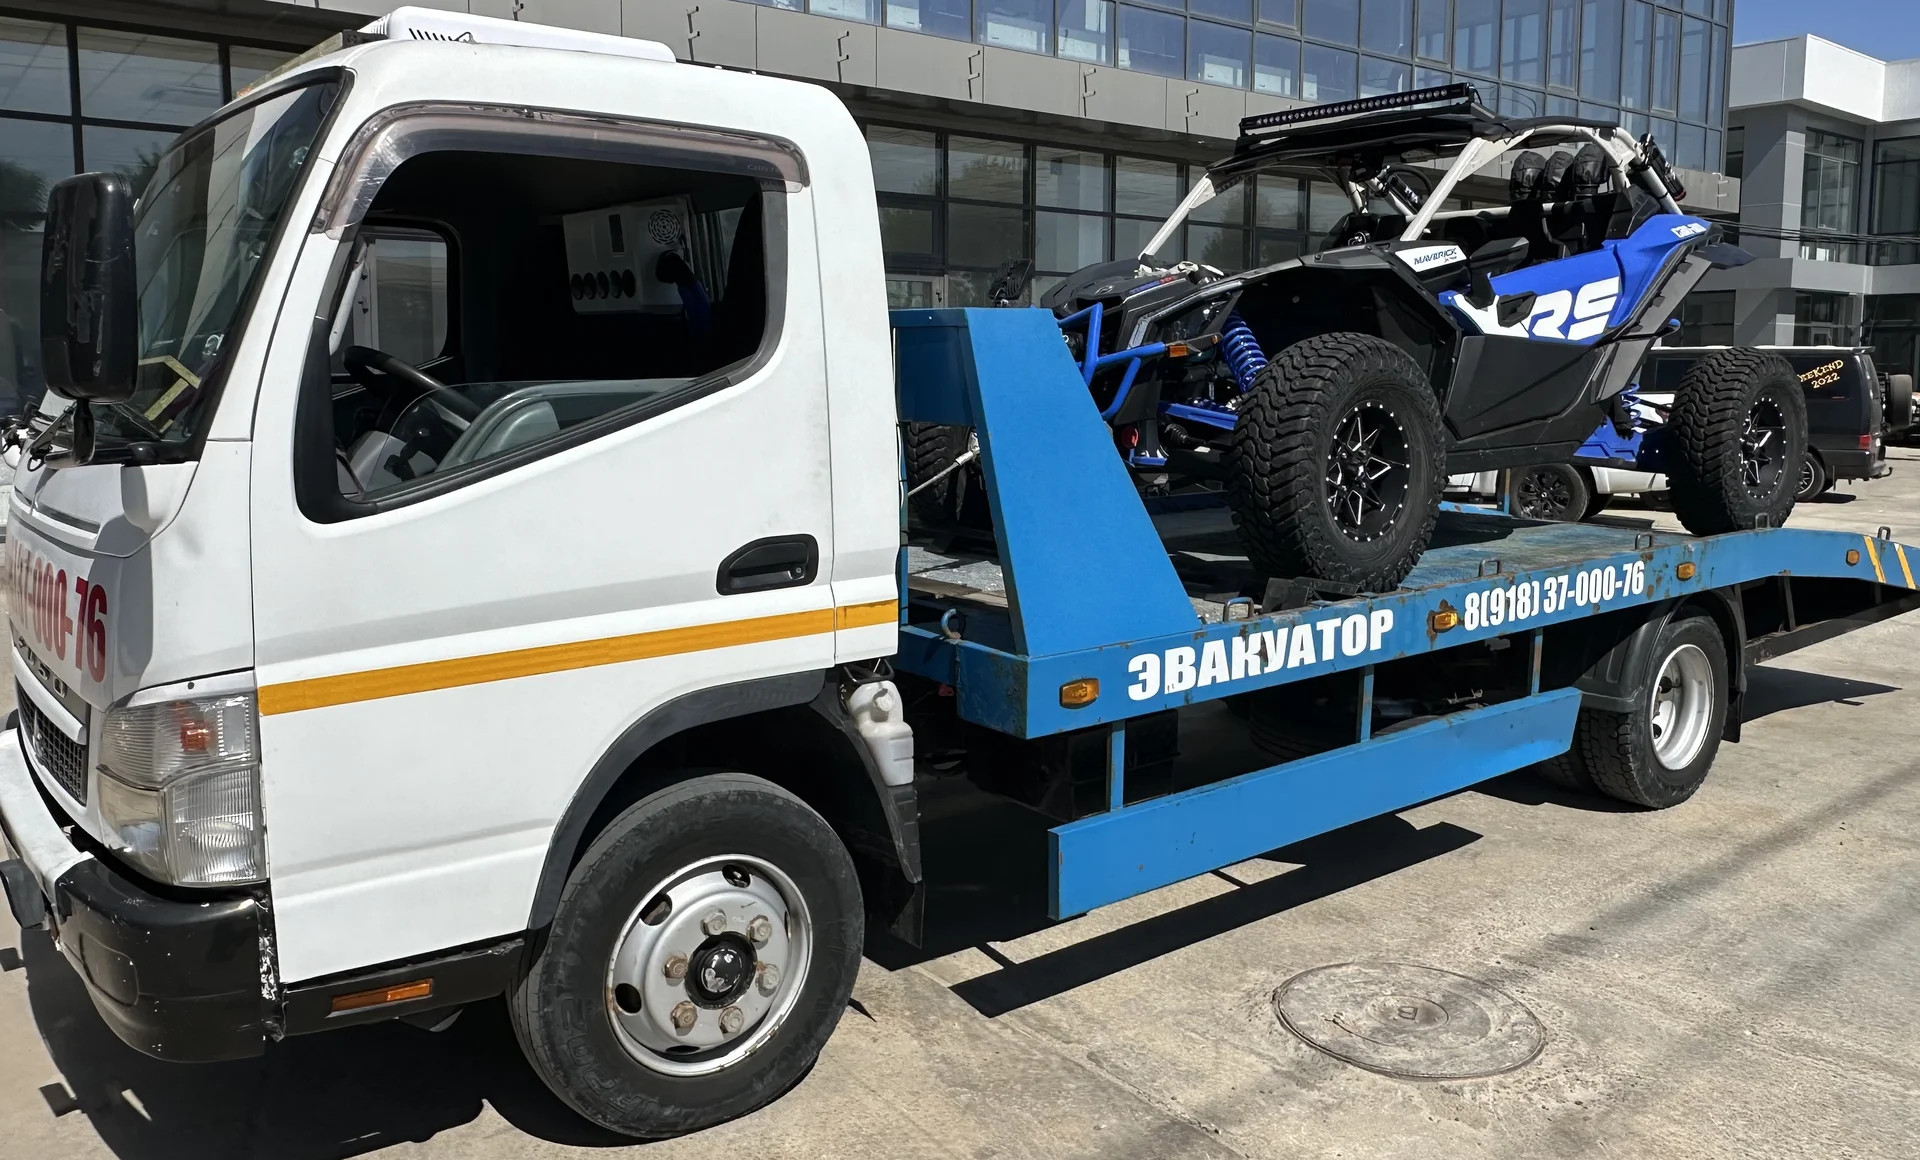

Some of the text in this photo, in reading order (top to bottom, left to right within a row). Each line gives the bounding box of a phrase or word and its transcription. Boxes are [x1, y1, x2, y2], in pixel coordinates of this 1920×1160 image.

[1796, 359, 1844, 383] EEKEND
[1811, 372, 1841, 389] 2022
[1464, 560, 1645, 631] 8(918) 37-000-76
[1127, 608, 1394, 701] ЭВАКУАТОР
